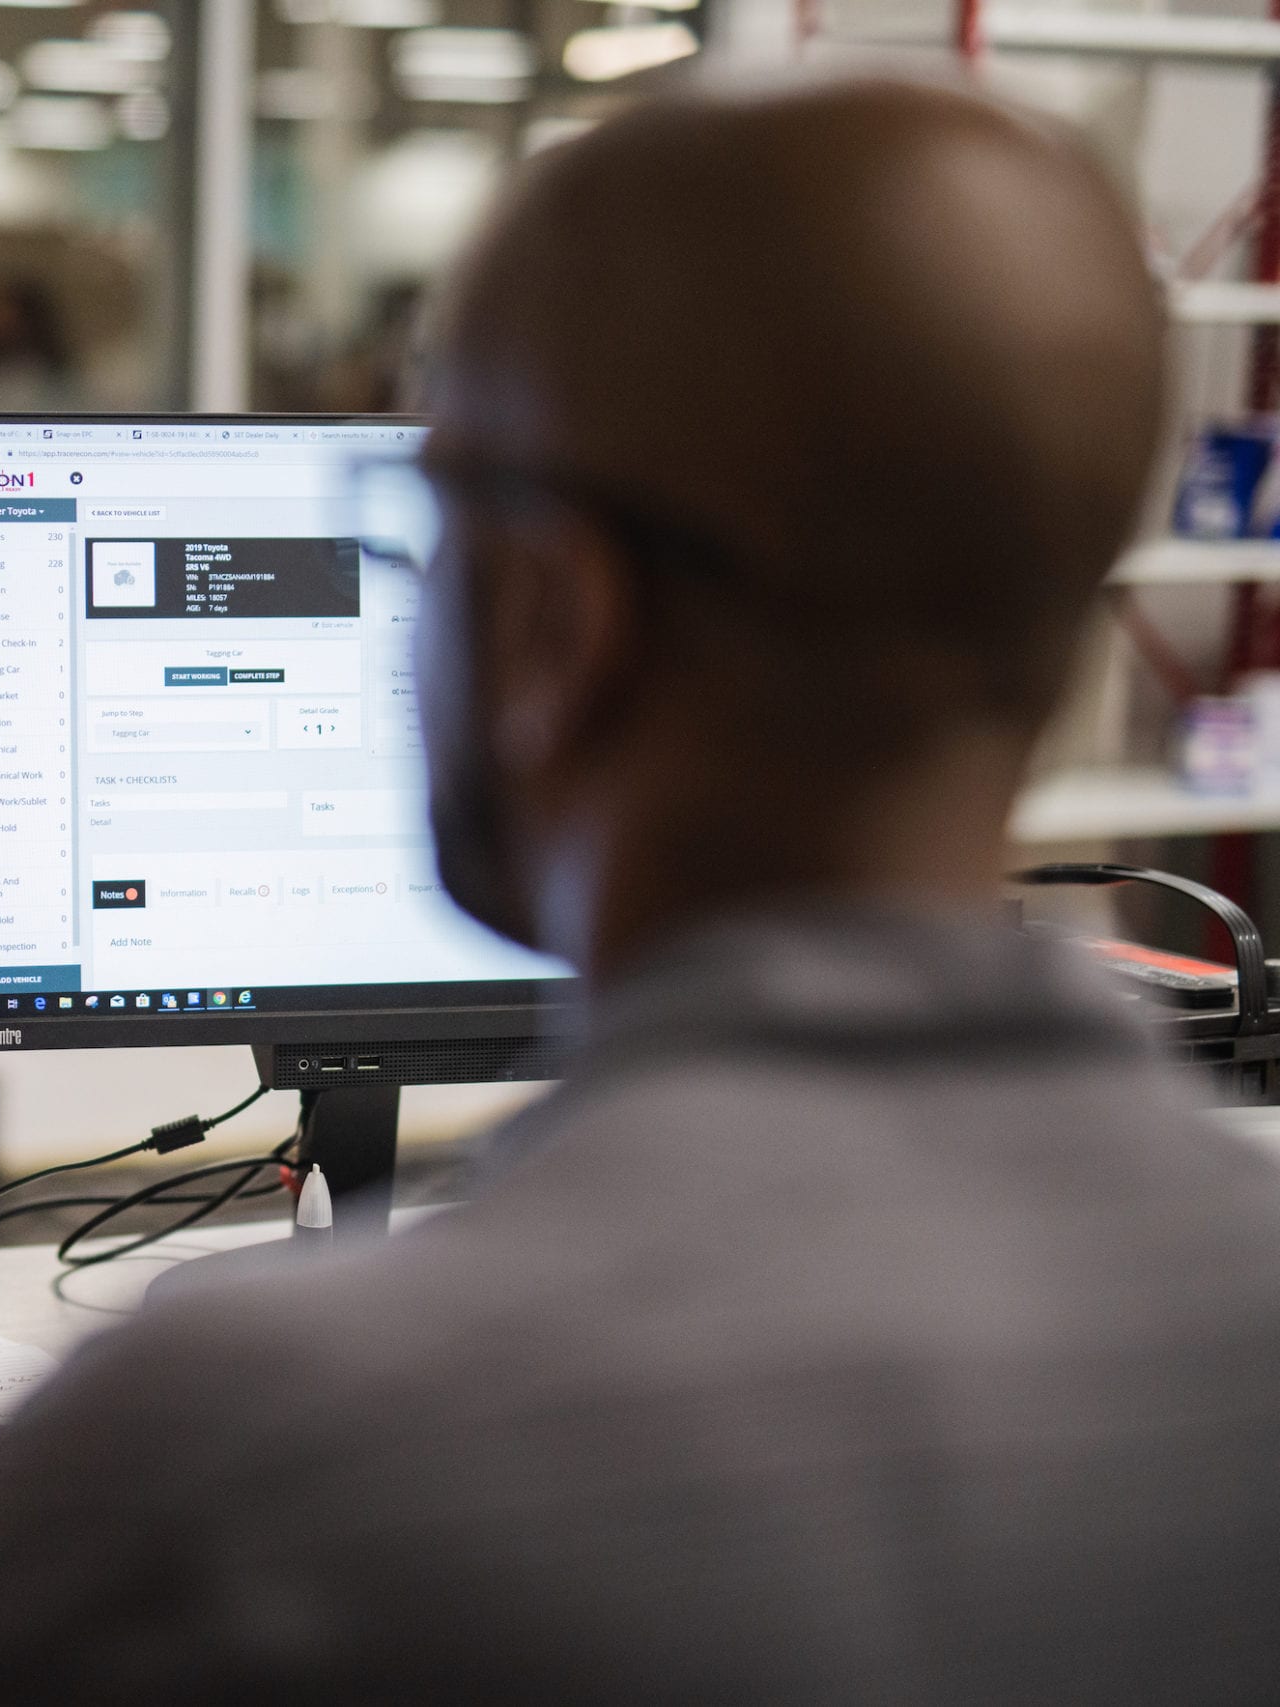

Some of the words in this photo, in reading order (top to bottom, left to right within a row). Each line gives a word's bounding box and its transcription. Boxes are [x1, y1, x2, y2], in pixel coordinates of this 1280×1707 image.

[321, 431, 340, 439] Search
[341, 431, 358, 439] results
[27, 471, 34, 487] 1
[7, 506, 36, 517] Toyota
[47, 532, 63, 541] 230
[185, 543, 203, 551] 2019
[203, 543, 228, 553] Toyota
[185, 553, 213, 561] Tacoma
[214, 553, 232, 561] 4WD
[47, 559, 63, 568] 228
[200, 563, 210, 571] V6
[58, 585, 64, 594] 0
[186, 604, 201, 612] AGE:
[213, 604, 228, 613] days
[58, 611, 64, 620] 0
[1, 639, 37, 648] Check-In
[58, 638, 64, 647] 2
[206, 650, 231, 658] Tagging
[232, 649, 243, 657] Car
[6, 665, 20, 674] Car
[58, 691, 65, 700] 0
[101, 710, 119, 718] Jump
[129, 709, 144, 718] Step
[299, 707, 318, 715] Detail
[319, 706, 339, 714] Grade
[59, 717, 65, 727] 0
[112, 729, 137, 738] Tagging
[138, 729, 150, 737] Car
[316, 724, 322, 735] 1
[59, 744, 65, 753] 0
[21, 770, 43, 780] Work
[59, 770, 66, 779] 0
[95, 776, 117, 784] TASK
[126, 775, 178, 784] CHECKLISTS
[59, 796, 66, 805] 0
[90, 799, 111, 807] Tasks
[310, 801, 335, 812] Tasks
[90, 817, 112, 826] Detail
[60, 823, 66, 832] 0
[60, 849, 67, 858] 0
[2, 877, 19, 886] And
[61, 888, 67, 897] 0
[100, 890, 125, 899] Notes
[160, 888, 208, 898] Information
[229, 887, 257, 896] Recalls
[292, 886, 311, 897] Logs
[332, 884, 374, 896] Exceptions
[61, 914, 67, 923] 0
[61, 941, 67, 950] 0
[110, 938, 128, 947] Add
[130, 938, 153, 946] Note
[12, 975, 42, 984] VEHICLE
